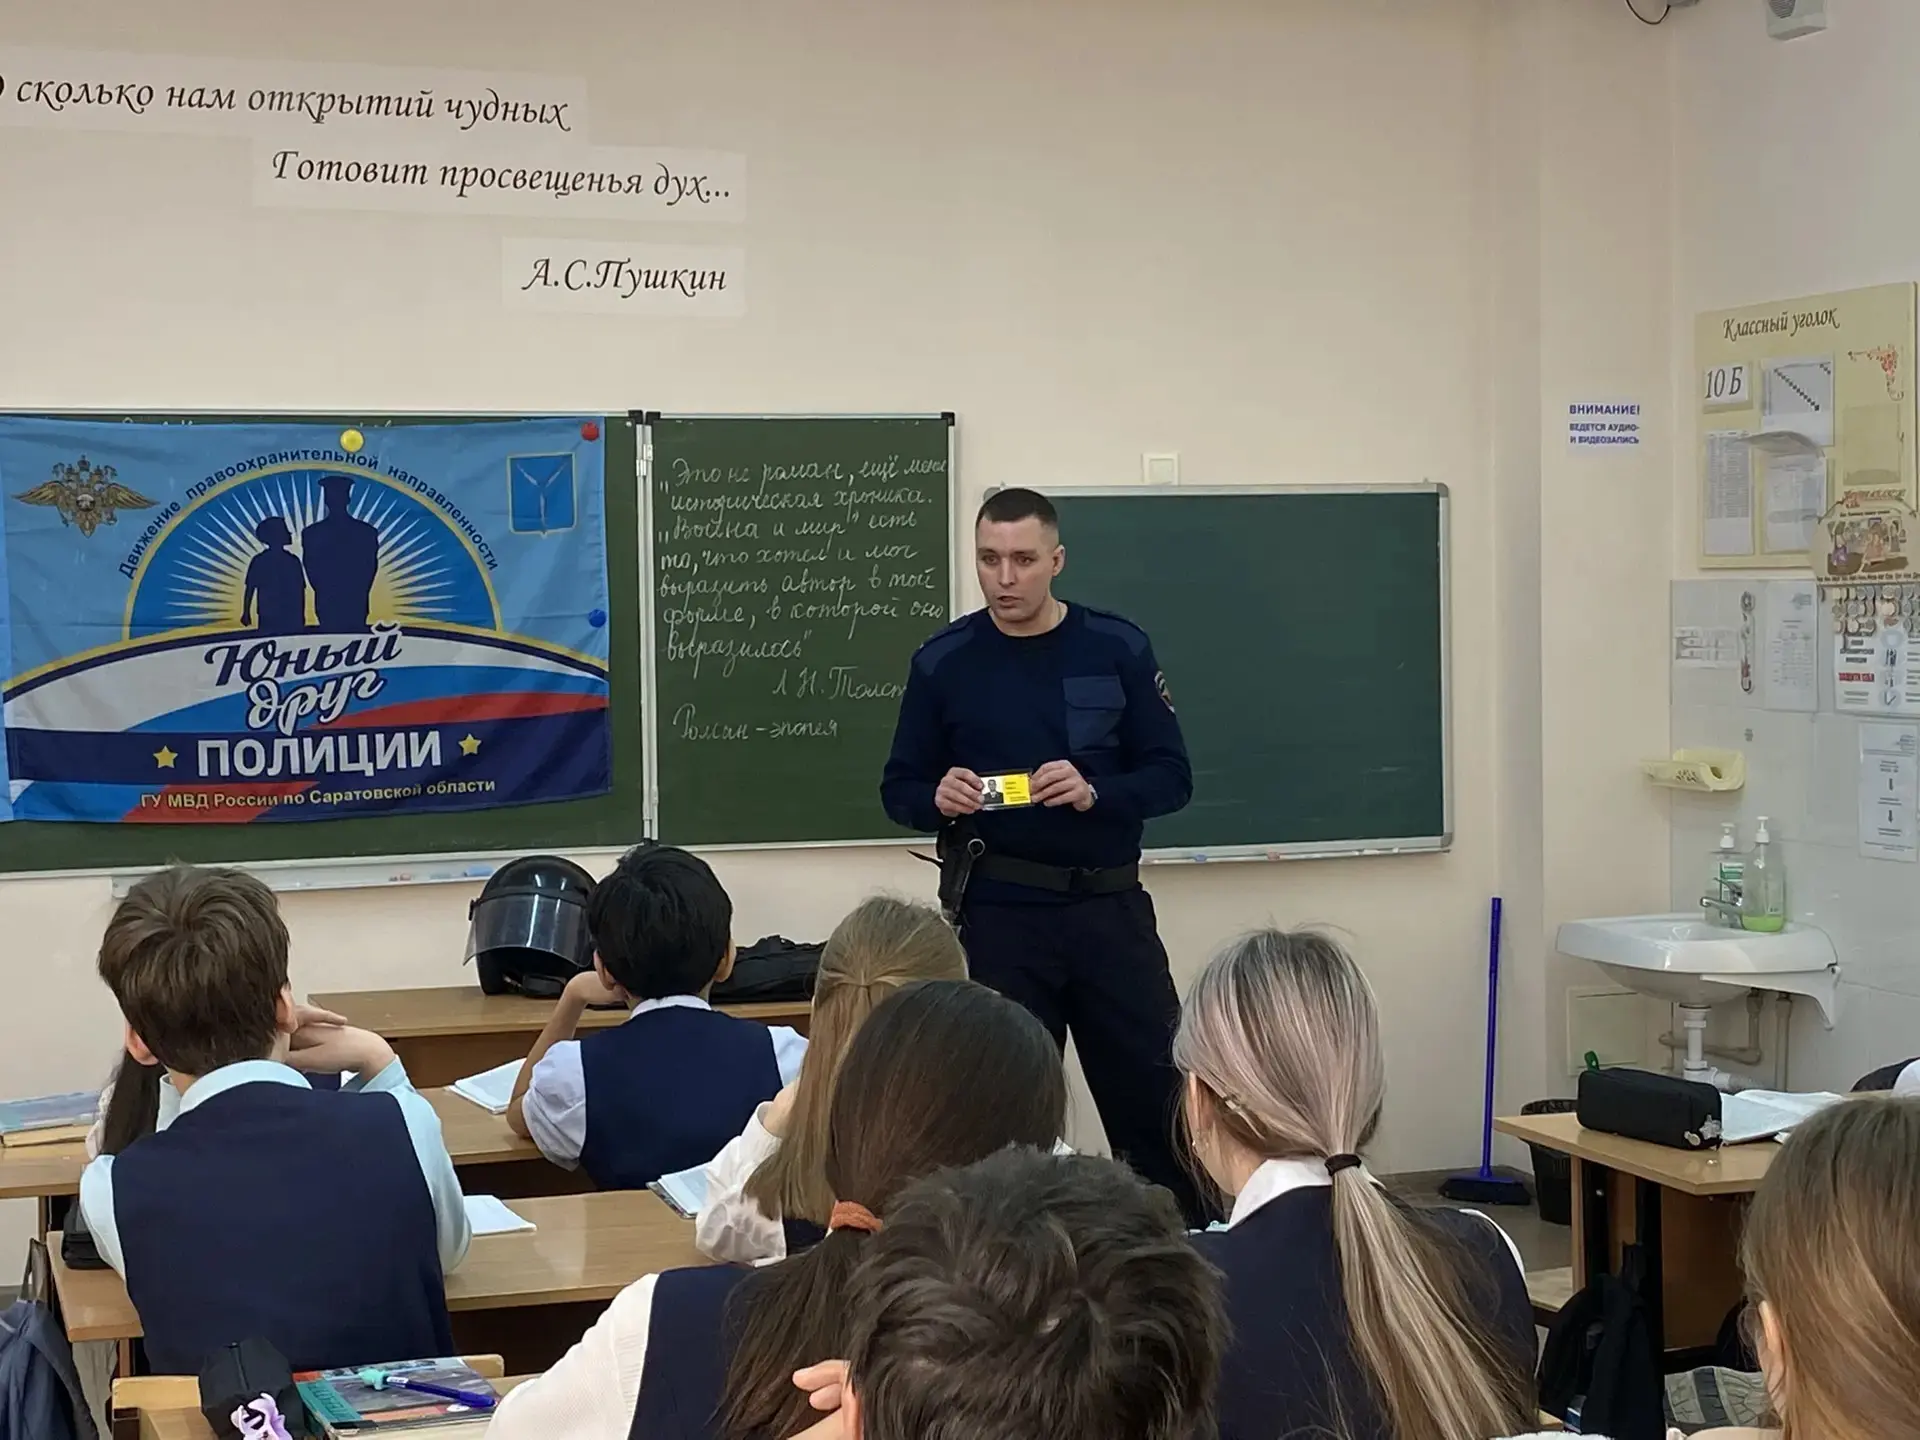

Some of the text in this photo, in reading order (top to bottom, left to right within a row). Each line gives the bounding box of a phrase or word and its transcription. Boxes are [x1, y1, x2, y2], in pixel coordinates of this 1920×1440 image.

[17, 80, 155, 115] сколько
[165, 85, 237, 111] нам
[247, 88, 436, 124] открытий
[443, 87, 572, 132] чудных
[272, 151, 731, 206] Готовит просвещенья дух...
[520, 257, 728, 299] А.С.Пушкин
[1723, 307, 1841, 342] Классный уголок
[1705, 366, 1744, 399] 10 Б
[1569, 404, 1640, 415] ВНИМАНИЕ!
[1569, 423, 1606, 432] ВЕДЕТСЯ
[1569, 436, 1640, 445] И ВИДЕОЗАПИСЬ
[118, 448, 499, 580] Движение правоохранительной направленности
[772, 522, 785, 537] и
[868, 510, 918, 530] есть
[837, 547, 856, 562] и
[656, 573, 768, 616] выразить
[780, 567, 857, 611] автор
[868, 563, 882, 589] в
[765, 594, 783, 621] в
[789, 596, 901, 642] которой
[203, 621, 403, 687] Юный
[247, 668, 388, 737] друг
[197, 730, 442, 778] ПОЛИЦИИ
[141, 778, 496, 810] ГУ МВД России по Саратовской области
